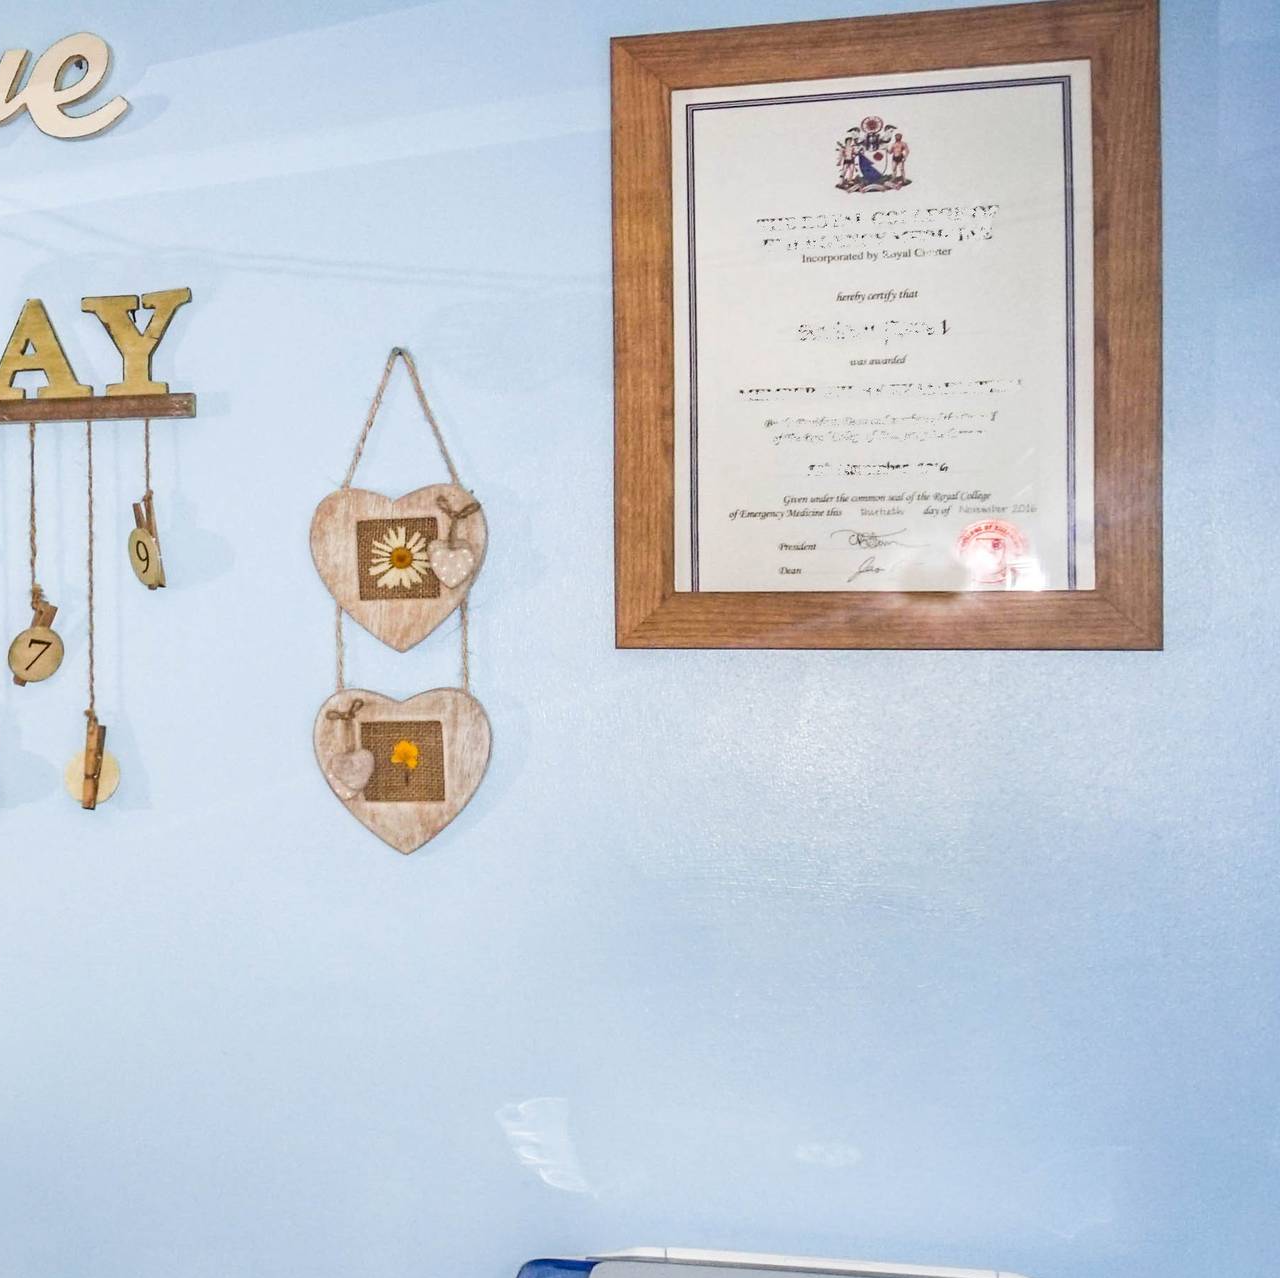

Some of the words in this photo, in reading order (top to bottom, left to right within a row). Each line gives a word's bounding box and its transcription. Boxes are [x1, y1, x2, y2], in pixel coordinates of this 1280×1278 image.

[802, 253, 865, 265] Incorporated
[866, 250, 878, 262] by
[836, 290, 865, 304] hereby
[867, 289, 897, 303] certify
[899, 289, 919, 300] that
[850, 357, 867, 367] was
[869, 353, 908, 366] awarded
[783, 495, 807, 506] Given
[810, 493, 834, 504] under
[835, 493, 849, 503] the
[851, 494, 885, 503] common
[905, 492, 916, 504] of
[917, 491, 930, 502] the
[729, 510, 739, 521] of
[740, 509, 784, 521] Emergency
[779, 542, 816, 552] President
[136, 540, 150, 574] 9
[779, 566, 801, 576] Dean
[24, 638, 53, 671] 7
